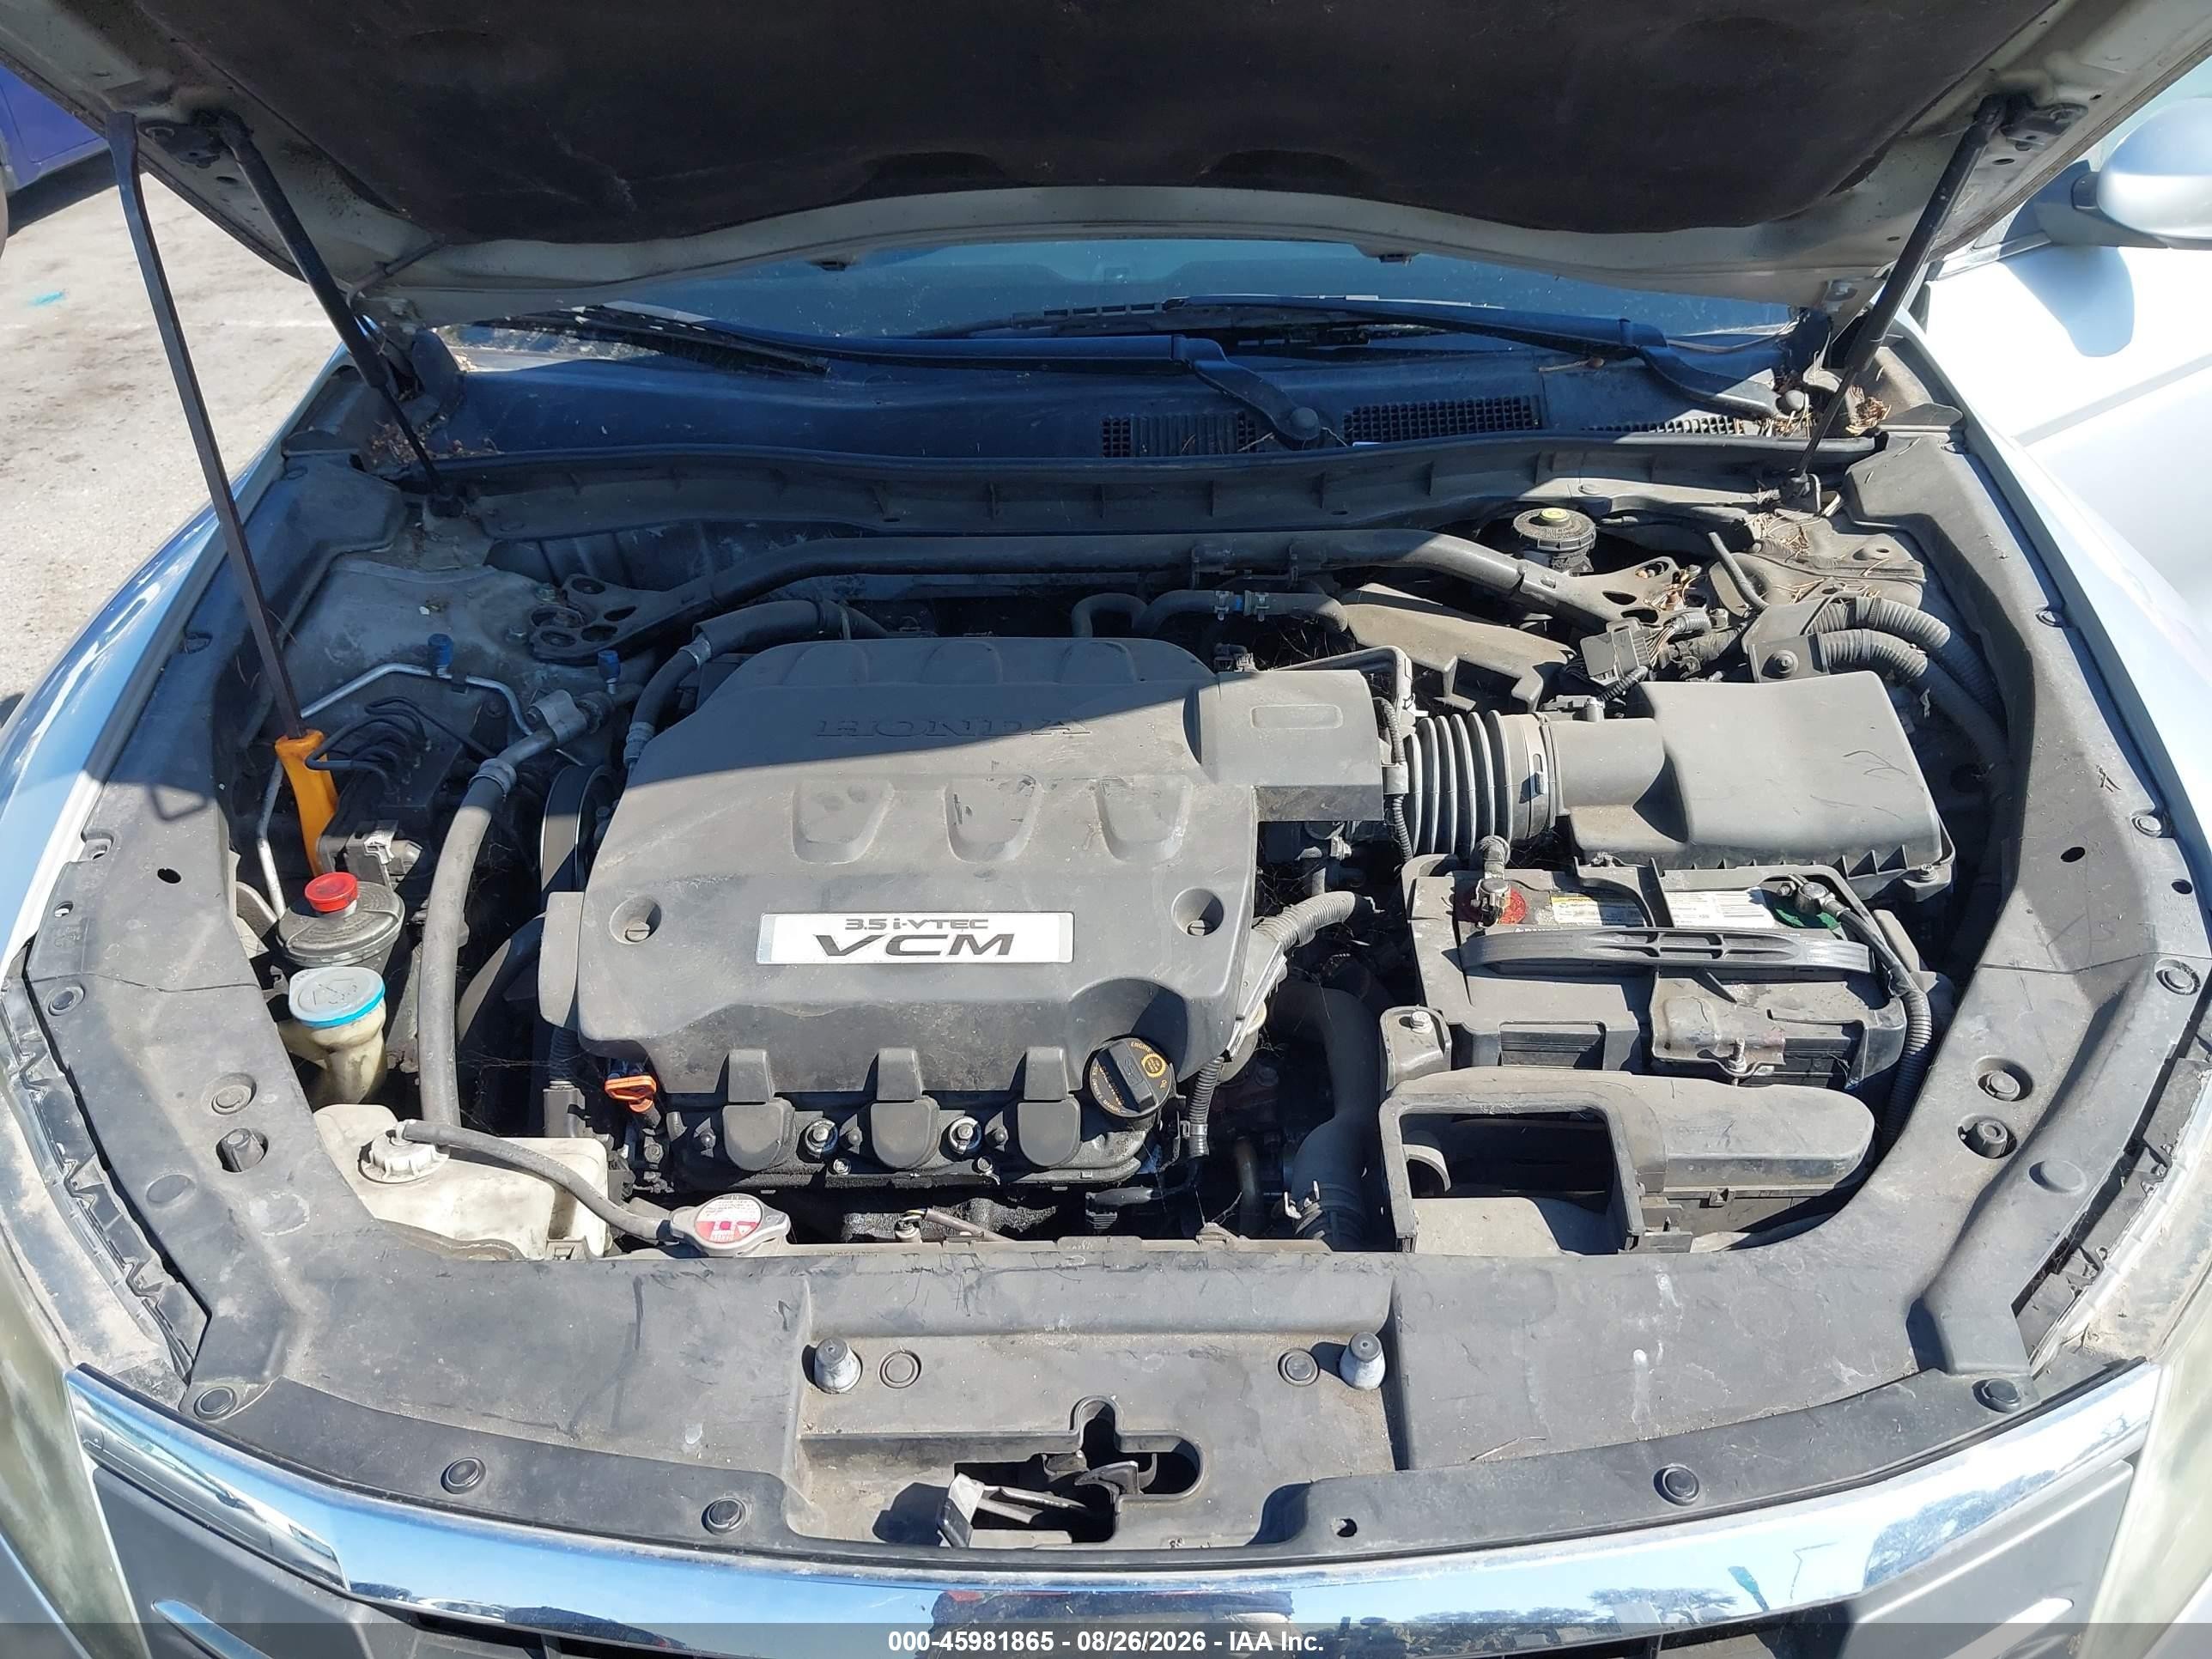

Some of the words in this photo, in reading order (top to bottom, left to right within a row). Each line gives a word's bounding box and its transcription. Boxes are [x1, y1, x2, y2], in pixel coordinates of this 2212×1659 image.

[817, 719, 1092, 737] HONDA
[845, 918, 887, 931] 3.5
[812, 933, 1015, 957] VCM
[1130, 1041, 1152, 1053] ENGINE
